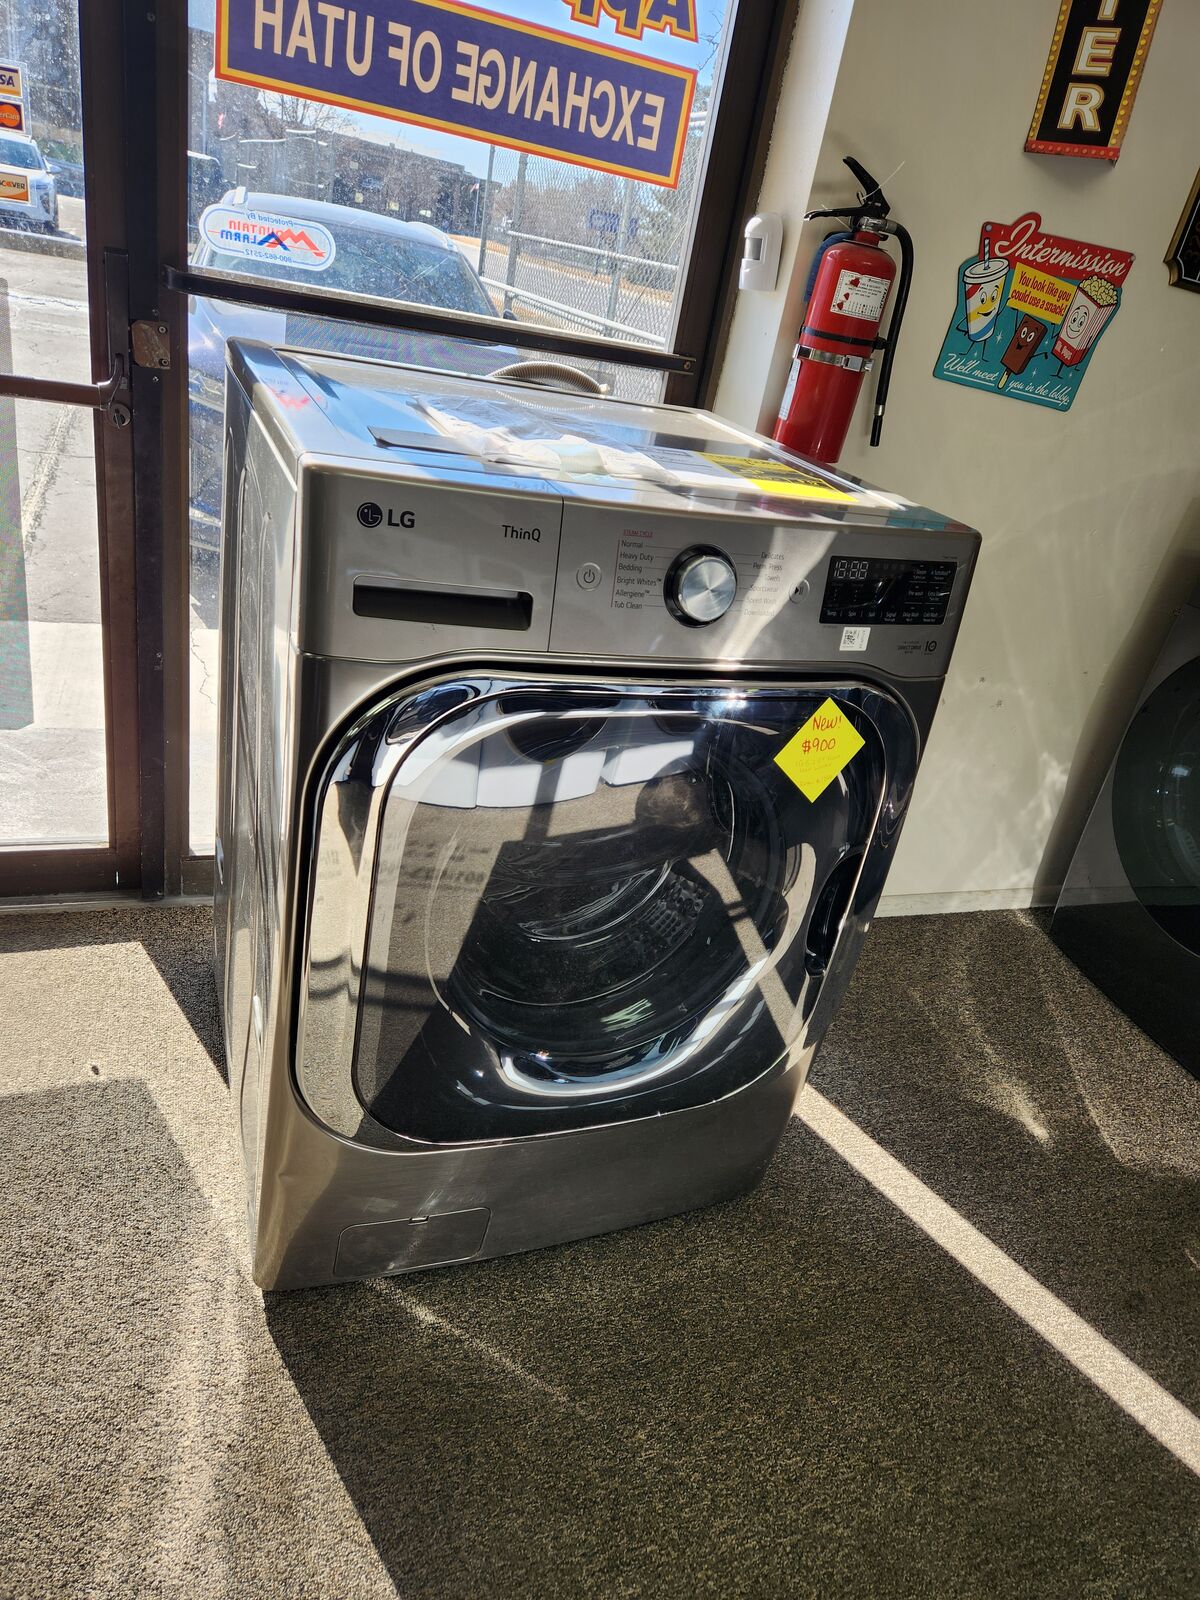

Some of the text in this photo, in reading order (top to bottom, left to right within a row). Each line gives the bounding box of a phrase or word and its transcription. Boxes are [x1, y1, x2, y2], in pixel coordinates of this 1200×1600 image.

[995, 220, 1126, 277] Intermission
[1019, 271, 1071, 302] You look like you
[1011, 289, 1068, 316] could use a snack!
[972, 370, 999, 381] meet
[1006, 380, 1023, 392] you
[1025, 383, 1035, 392] in
[1035, 381, 1050, 396] the
[387, 509, 416, 528] LG
[502, 525, 541, 543] ThinQ
[621, 540, 643, 548] Normal
[620, 552, 654, 562] Heavy Duty
[618, 563, 643, 574] Bedding
[616, 576, 635, 585] Bright
[614, 601, 643, 609] Tub Clean
[813, 715, 842, 731] New!
[802, 738, 836, 755] $900
